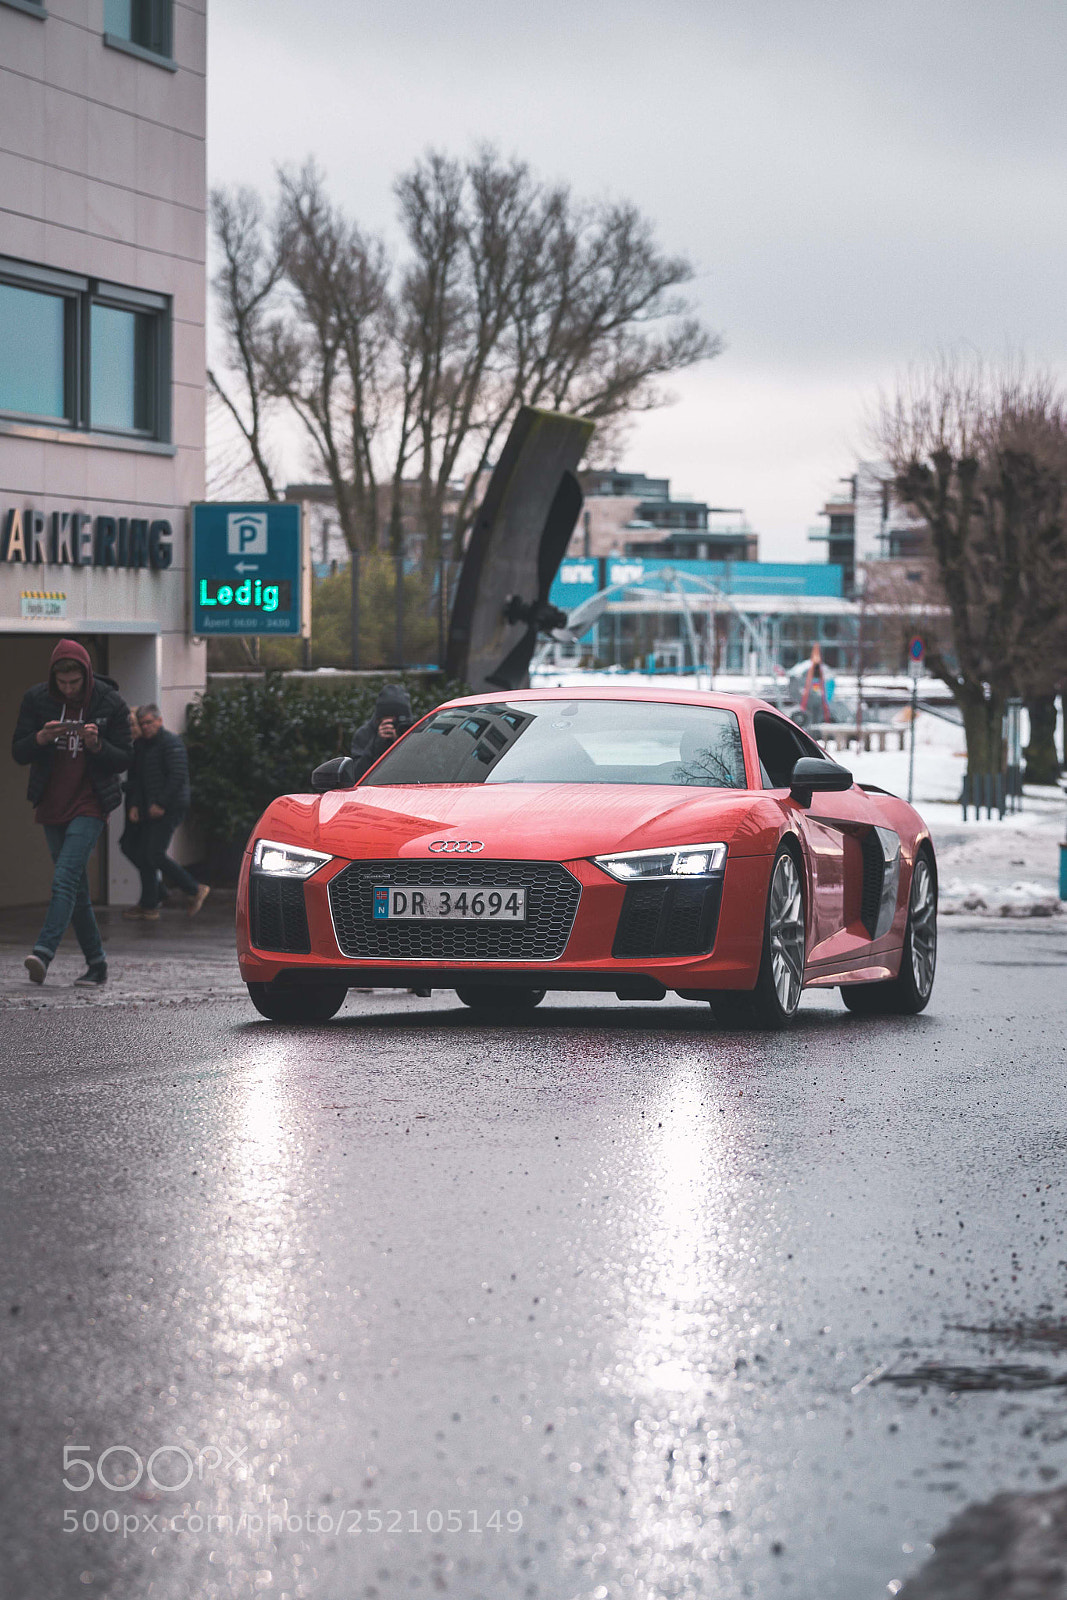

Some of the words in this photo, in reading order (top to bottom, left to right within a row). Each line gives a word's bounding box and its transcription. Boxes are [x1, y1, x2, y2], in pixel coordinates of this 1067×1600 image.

[240, 525, 257, 552] P
[200, 579, 279, 612] Ledig
[378, 906, 385, 914] N
[393, 891, 424, 915] DR
[439, 892, 520, 916] 34694
